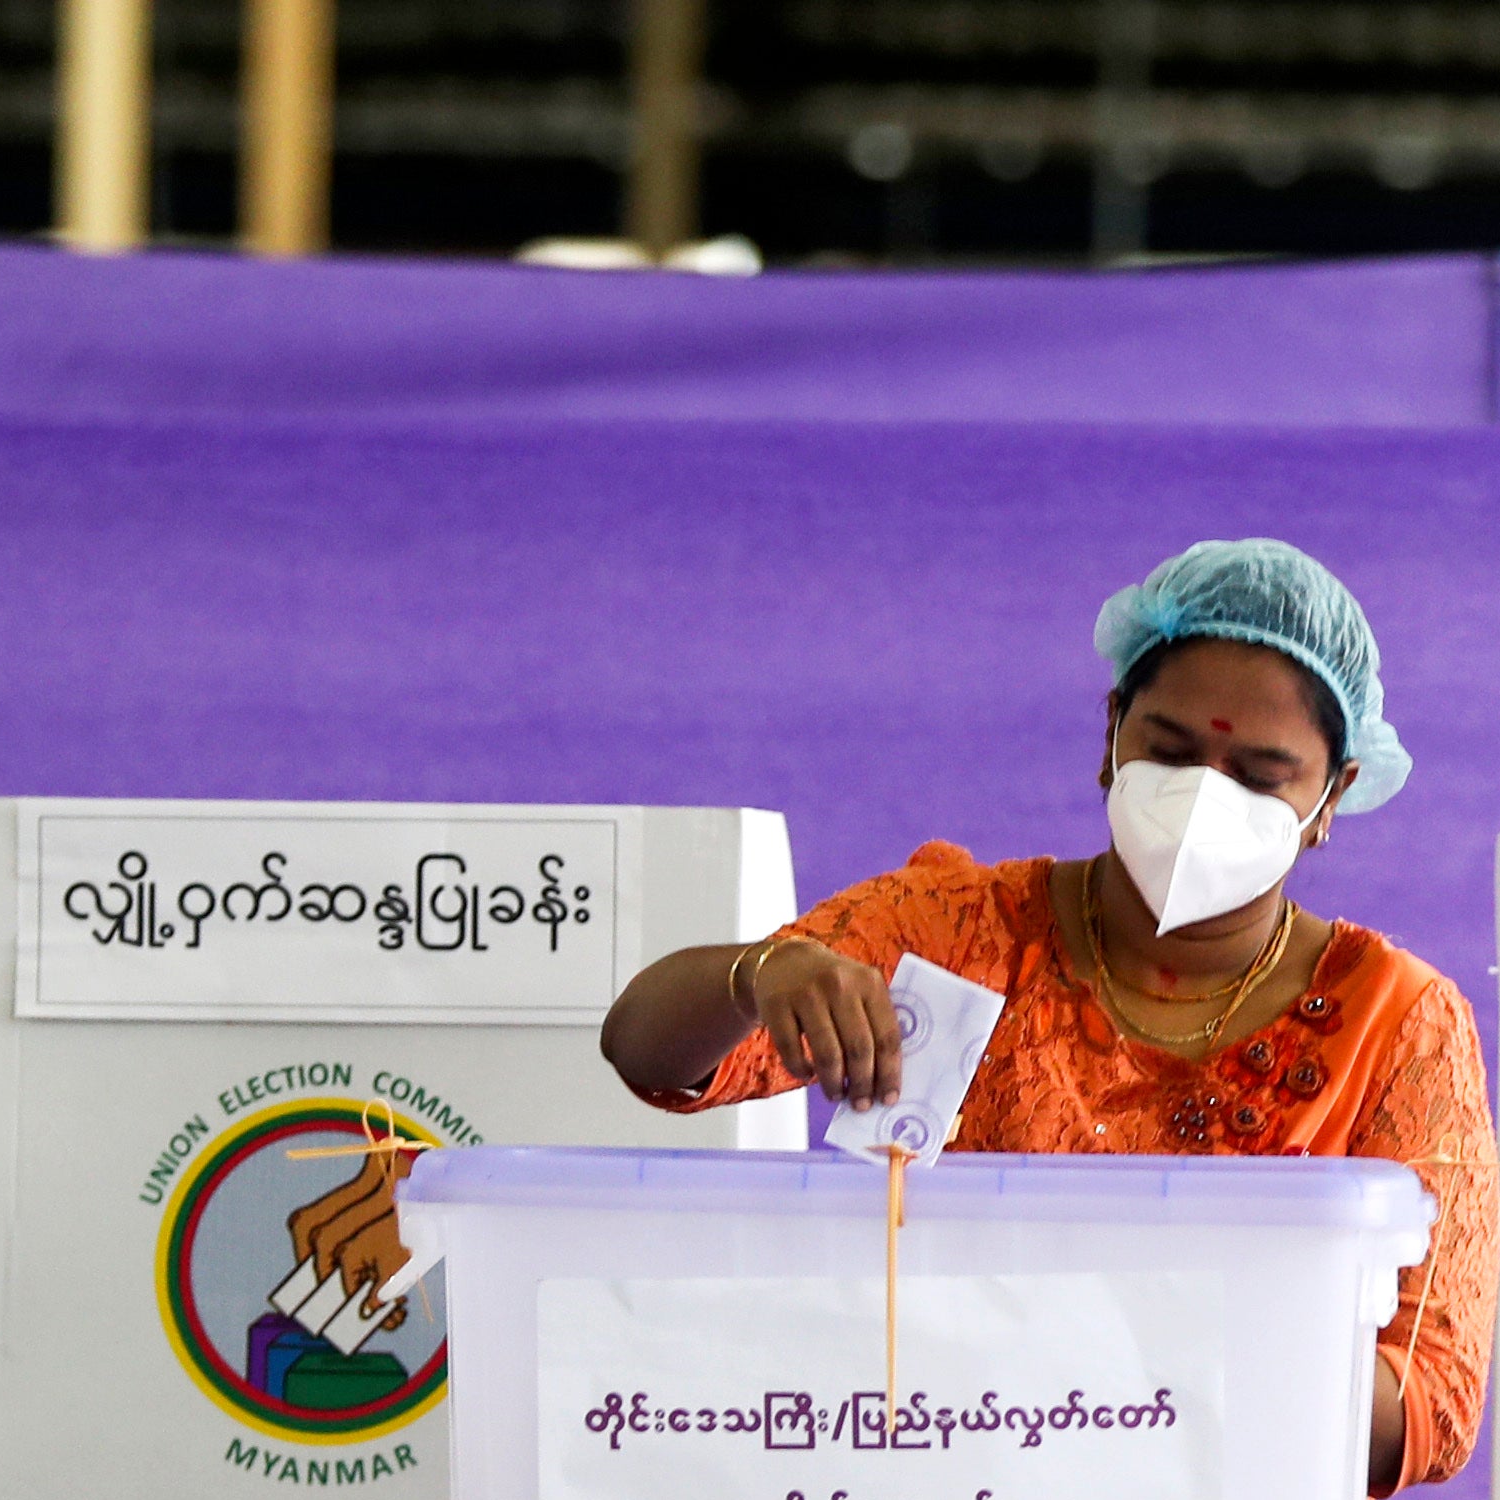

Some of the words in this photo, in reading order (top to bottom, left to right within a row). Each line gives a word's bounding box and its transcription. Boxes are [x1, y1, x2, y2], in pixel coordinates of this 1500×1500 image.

[63, 850, 592, 954] လျှို့ဝှက်ဆန္ဒပြုခန်း
[138, 1112, 211, 1207] UNION
[217, 1062, 353, 1115] ELECTION
[372, 1070, 485, 1148] COMMIS
[225, 1436, 419, 1487] MYANMAR
